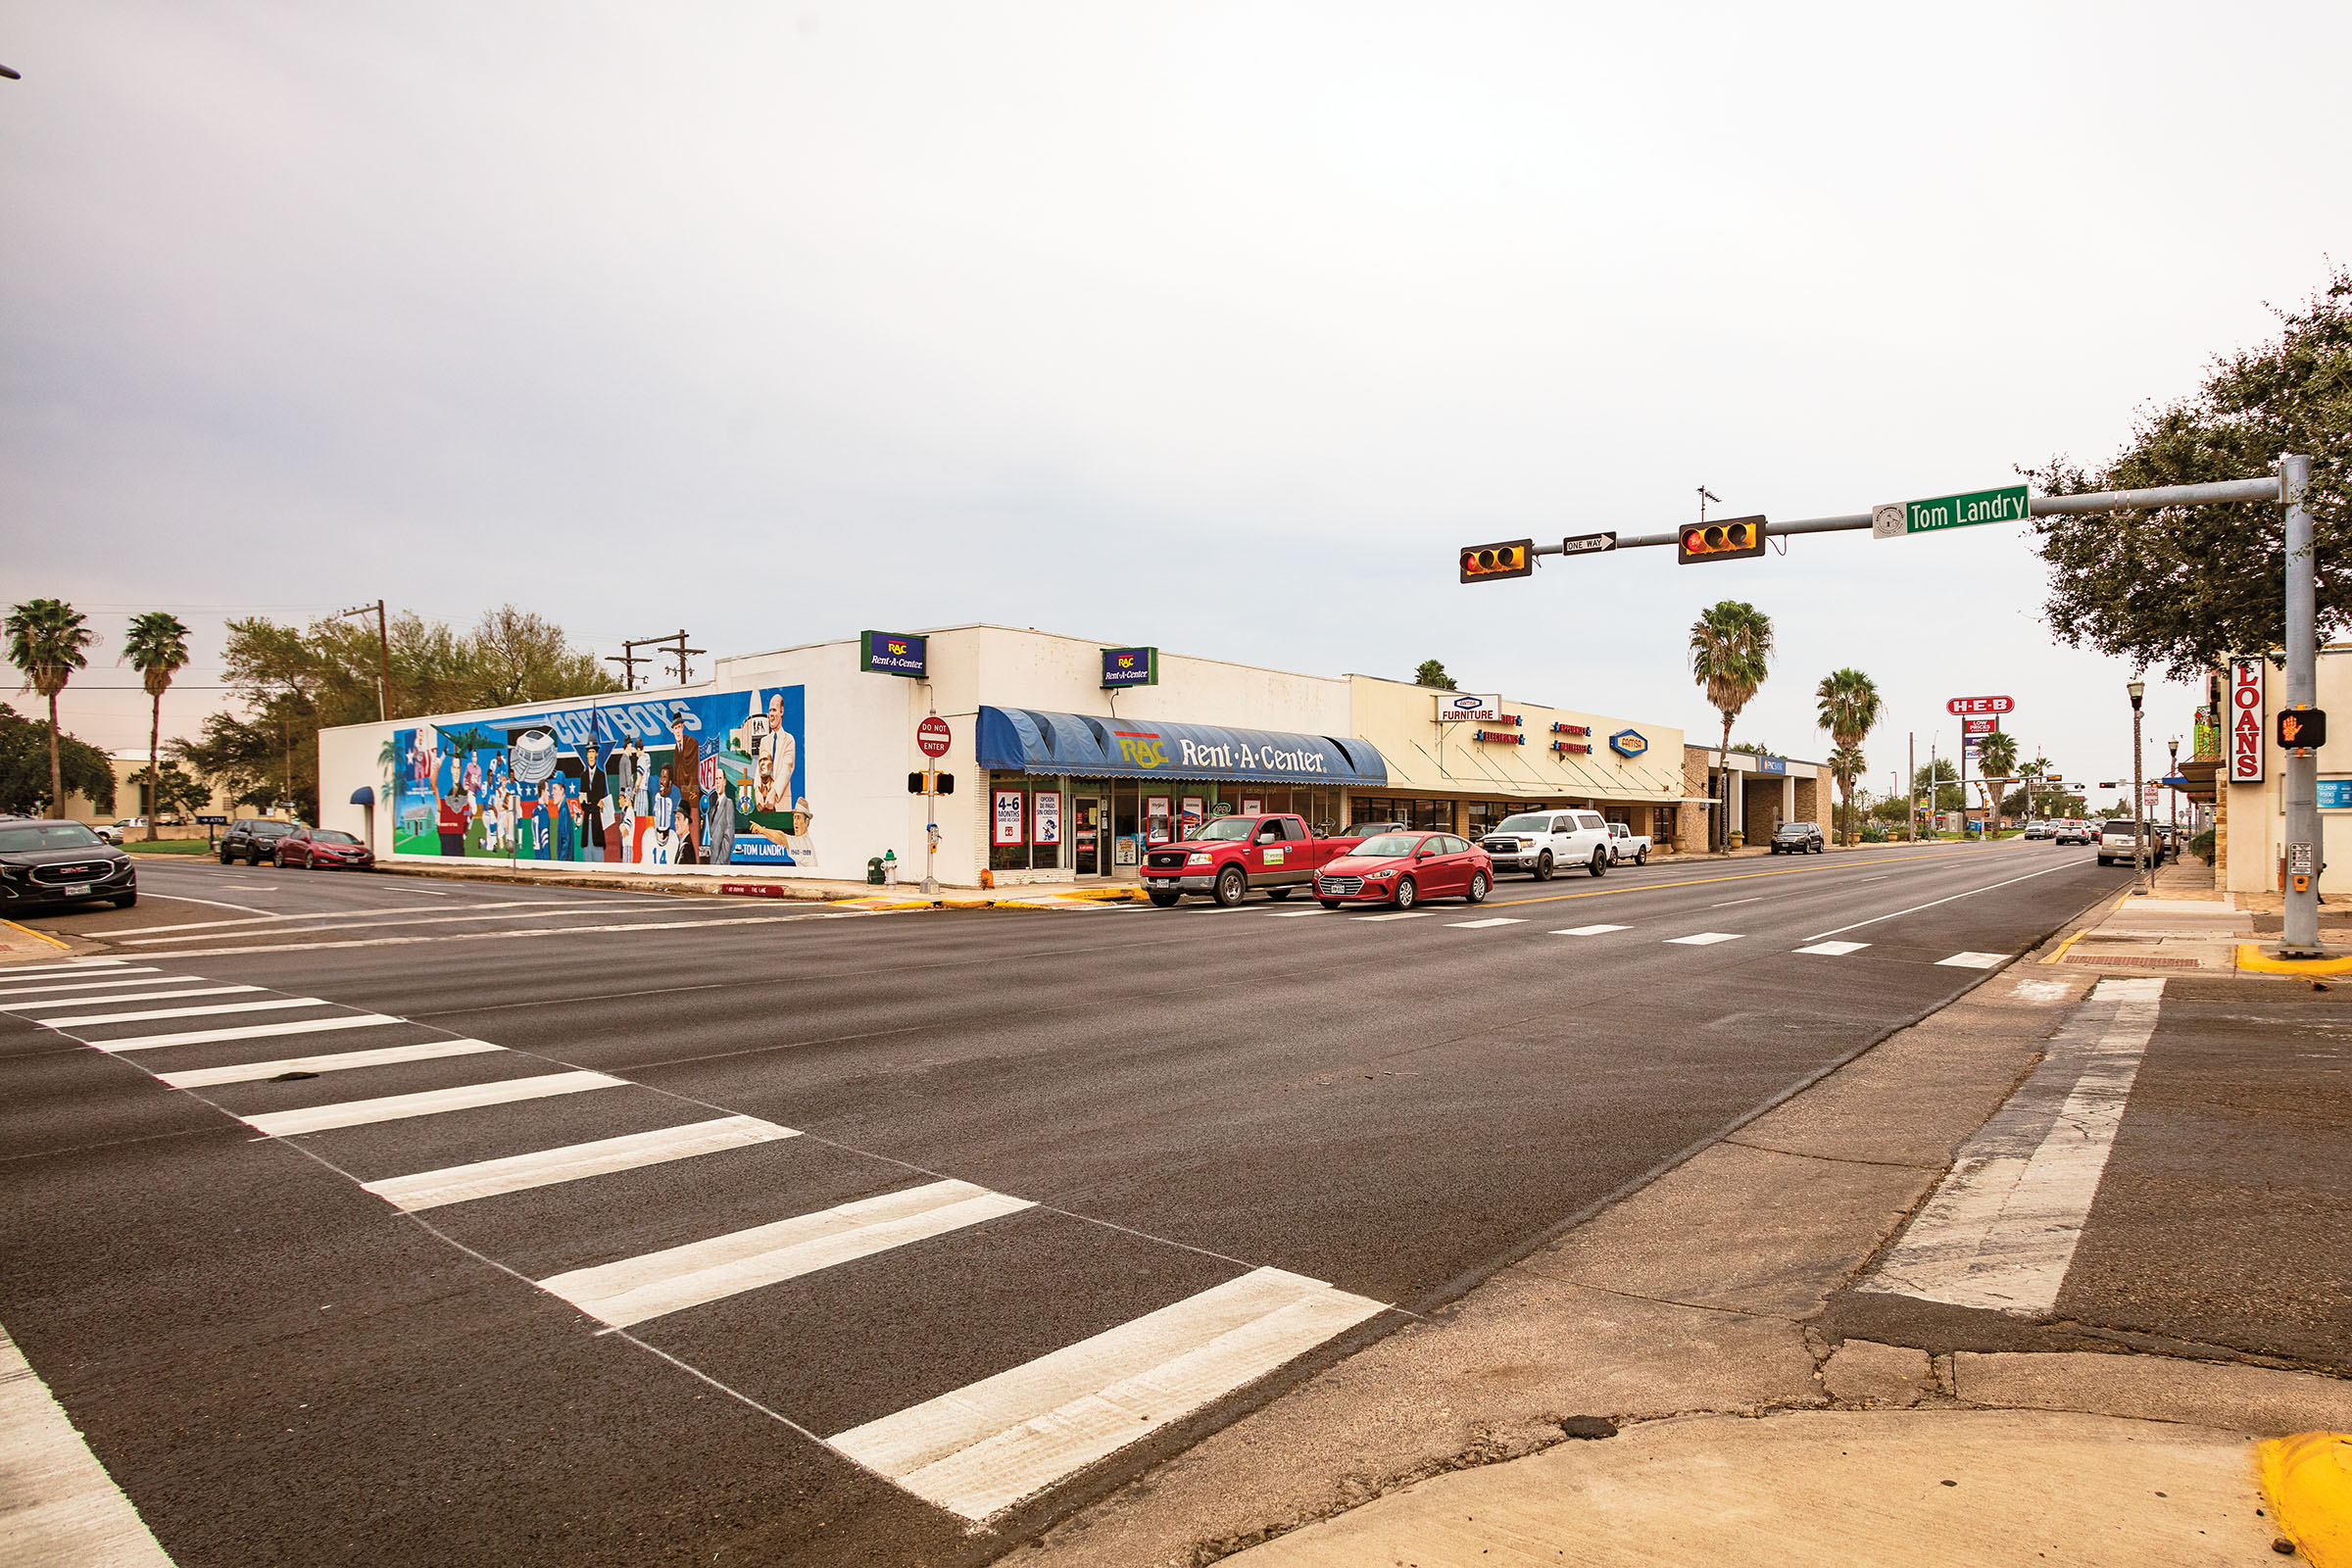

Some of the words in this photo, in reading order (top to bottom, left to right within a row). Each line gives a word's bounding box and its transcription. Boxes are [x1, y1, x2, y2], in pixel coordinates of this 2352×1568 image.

[1911, 505, 1948, 529] Tom
[1956, 493, 2025, 522] Landry
[1568, 540, 1583, 551] ONE
[1587, 538, 1602, 548] WAY
[888, 643, 907, 656] RAC
[1118, 657, 1134, 668] RAC
[1953, 699, 2007, 712] H-E-B
[1442, 710, 1494, 720] FURNITURE
[2234, 664, 2260, 777] LOANS
[1559, 723, 1587, 735] APPLIANCES
[1483, 731, 1519, 744] ELECTRONICS
[1621, 737, 1642, 749] FAMSA
[924, 742, 945, 751] ENTER
[1559, 742, 1588, 754] MATTRESSES
[1118, 738, 1169, 769] RAC
[998, 797, 1019, 810] 4-6
[652, 847, 666, 864] 14
[743, 844, 759, 856] TOM
[760, 844, 785, 857] LANDRY
